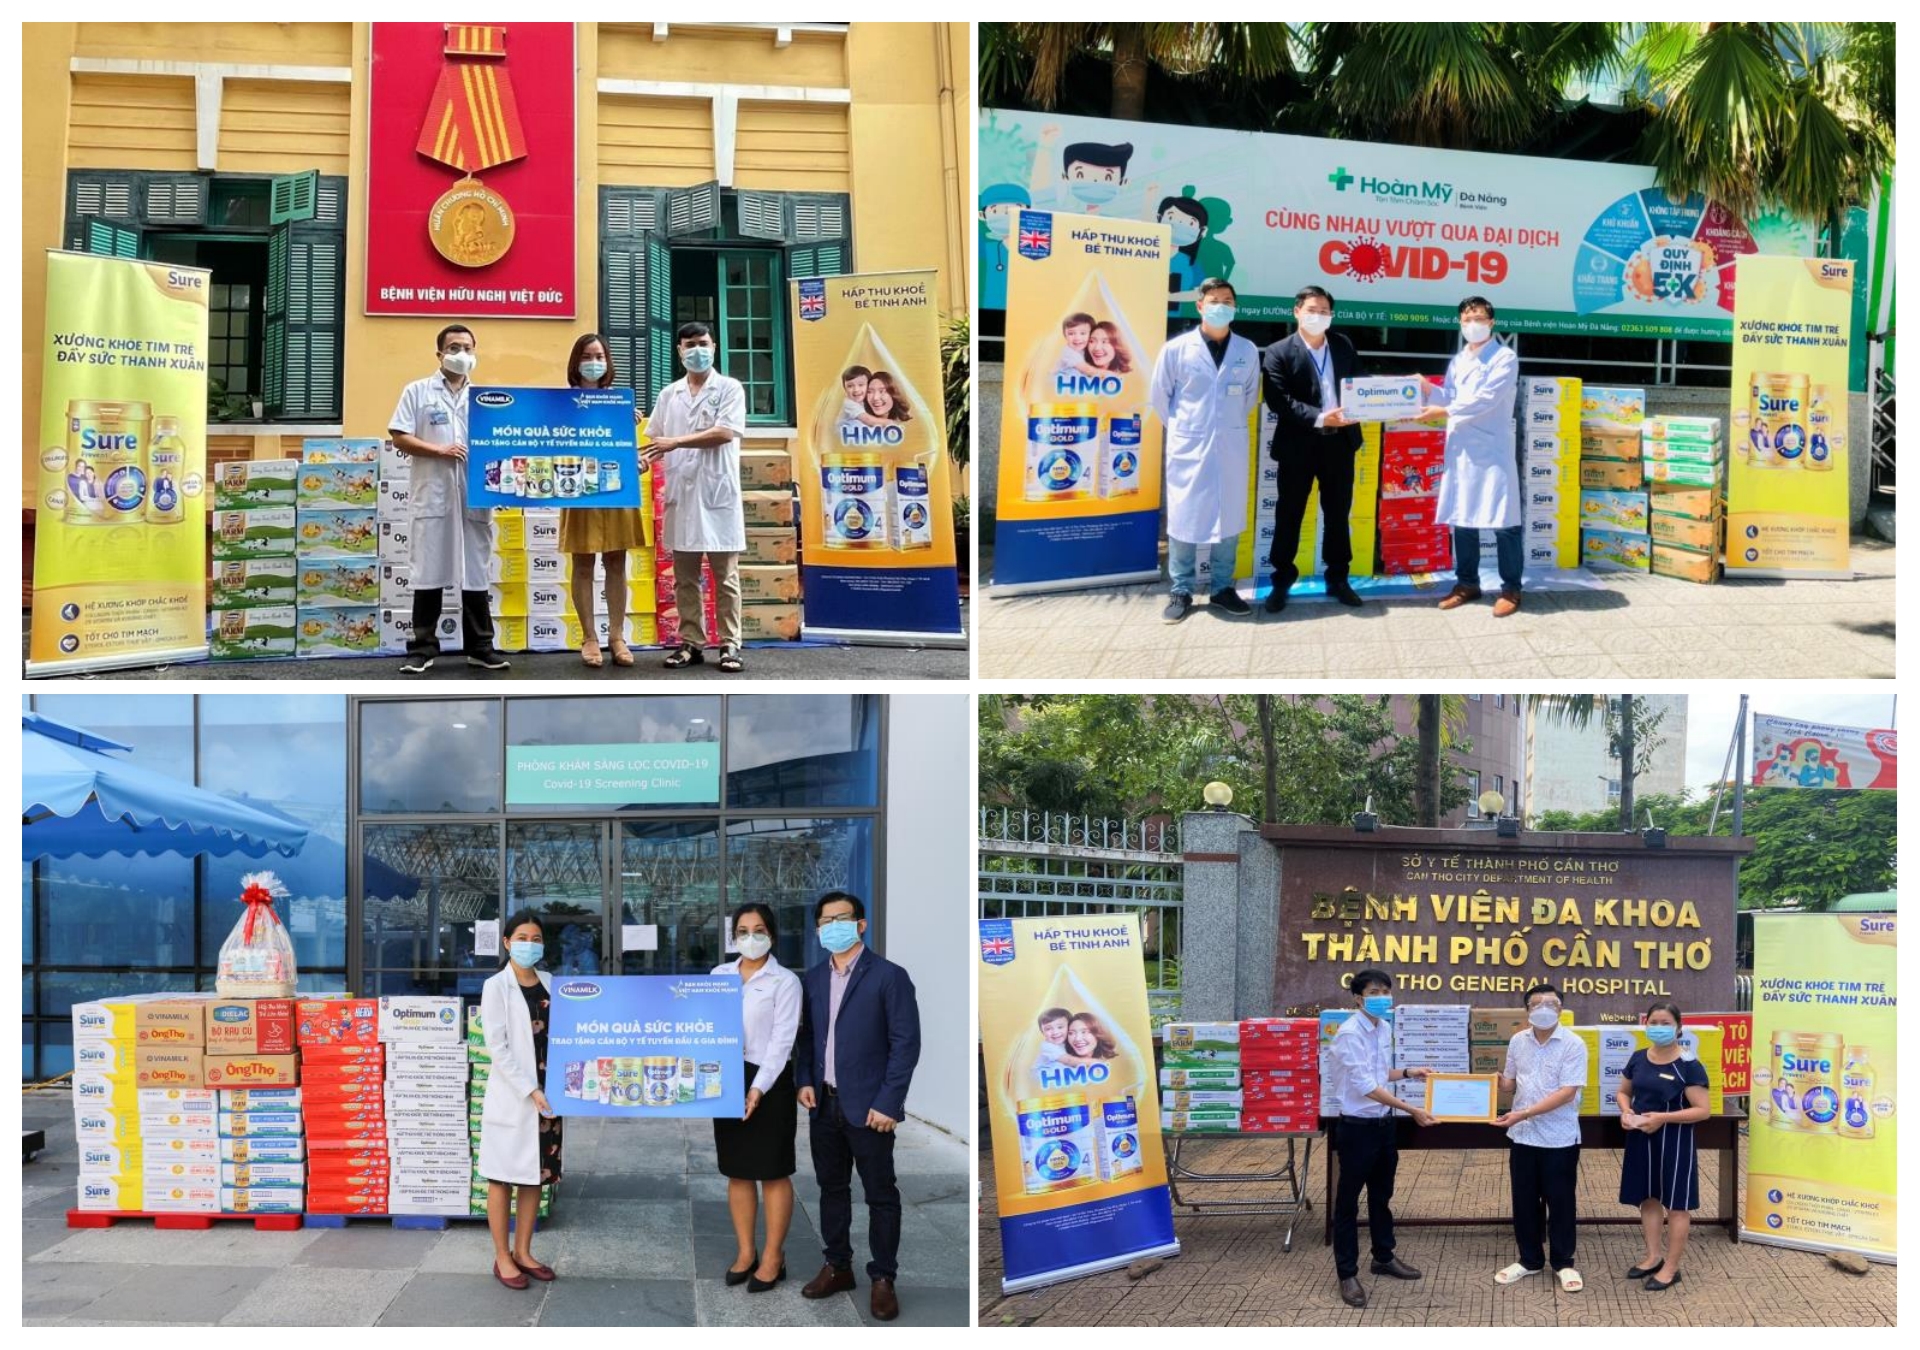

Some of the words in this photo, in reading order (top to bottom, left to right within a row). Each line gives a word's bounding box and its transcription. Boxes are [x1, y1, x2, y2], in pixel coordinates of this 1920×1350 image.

[1360, 176, 1417, 197] Hoàn
[1422, 181, 1453, 203] Mỹ
[1460, 192, 1475, 201] Đà
[1265, 208, 1320, 231] CÙNG
[1326, 215, 1380, 236] NHAU
[1386, 218, 1436, 243] VƯỢT
[1441, 223, 1479, 243] QUA
[1483, 225, 1513, 248] ĐẠI
[1518, 227, 1560, 250] DỊCH
[1072, 229, 1098, 241] HẤP
[1100, 233, 1125, 244] THU
[1104, 246, 1132, 256] TINH
[1134, 249, 1160, 259] ANH
[1663, 248, 1689, 259] QUY
[1660, 260, 1691, 273] ĐỊNH
[1821, 264, 1848, 277] Sure
[167, 271, 202, 288] Sure
[380, 285, 414, 302] BỆNH
[417, 286, 445, 303] VIỆN
[449, 286, 475, 301] HỮU
[477, 289, 506, 304] NGHỊ
[509, 288, 534, 305] VIỆT
[538, 288, 563, 303] ĐỨC
[842, 286, 865, 298] HẤP
[868, 286, 891, 296] THU
[872, 298, 899, 307] TINH
[902, 297, 927, 306] ANH
[1389, 313, 1409, 322] 1900
[1410, 314, 1429, 323] 9095
[1740, 319, 1775, 331] XƯƠNG
[1805, 324, 1822, 333] TIM
[53, 332, 104, 349] XƯƠNG
[146, 341, 169, 353] TIM
[1765, 333, 1783, 344] SỨC
[1786, 336, 1820, 346] THANH
[1822, 336, 1848, 347] XUÂN
[89, 351, 116, 365] SỨC
[121, 355, 166, 368] THANH
[170, 357, 205, 371] XUÂN
[1057, 375, 1122, 395] HMO
[1533, 385, 1554, 394] Sure
[480, 395, 510, 403] VINAMILK
[1357, 387, 1398, 398] Optimum
[1759, 394, 1800, 413] Sure
[493, 424, 522, 437] MÓN
[524, 425, 550, 438] QUÀ
[552, 425, 576, 437] SỨC
[579, 425, 612, 437] KHỎE
[842, 426, 902, 445] HMO
[1035, 423, 1089, 436] Optimum
[81, 427, 137, 450] Sure
[828, 473, 876, 484] Optimum
[1533, 493, 1553, 503] Sure
[533, 557, 558, 568] Sure
[517, 759, 555, 771] PHÒNG
[559, 758, 590, 771] KHÁM
[594, 758, 625, 770] SÀNG
[628, 760, 650, 771] LỌC
[654, 759, 708, 770] COVID-19
[544, 779, 592, 789] Covid-19
[595, 779, 648, 790] Screening
[651, 778, 681, 788] Clinic
[1402, 853, 1421, 867] SỞ
[1427, 857, 1436, 868] Y
[1441, 854, 1460, 869] TẾ
[1465, 857, 1514, 869] THÀNH
[1518, 857, 1549, 871] PHỐ
[1588, 861, 1619, 873] THƠ
[1407, 872, 1428, 881] CAN
[1432, 872, 1452, 881] THO
[1455, 873, 1479, 882] CITY
[1556, 876, 1570, 884] OF
[1572, 876, 1613, 885] HEALTH
[1310, 885, 1418, 927] BỆNH
[1430, 889, 1521, 932] VIỆN
[1531, 897, 1583, 926] ĐA
[1593, 898, 1701, 929] KHOA
[1860, 918, 1894, 931] Sure
[1034, 927, 1061, 940] HẤP
[1064, 929, 1090, 939] THU
[1069, 941, 1100, 950] TINH
[1103, 939, 1130, 948] ANH
[1301, 926, 1438, 964] THÀNH
[1449, 926, 1533, 967] PHỐ
[1541, 928, 1621, 969] CẦN
[1633, 937, 1712, 971] THƠ
[1401, 972, 1442, 992] THO
[1562, 977, 1672, 997] HOSPITAL
[1760, 978, 1802, 990] XƯƠNG
[1838, 982, 1861, 992] TIM
[1788, 991, 1812, 1003] SỨC
[1815, 994, 1857, 1005] THANH
[1861, 994, 1897, 1006] XUÂN
[80, 1015, 105, 1025] Sure
[393, 1008, 435, 1019] Optimum
[225, 1027, 239, 1035] RAU
[576, 1020, 609, 1033] MÓN
[611, 1020, 639, 1033] QUÀ
[644, 1020, 672, 1033] SỨC
[675, 1018, 714, 1033] KHỎE
[597, 1036, 615, 1045] CÁN
[616, 1037, 626, 1046] BỘ
[1606, 1038, 1629, 1047] Sure
[1783, 1053, 1831, 1073] Sure
[1041, 1063, 1109, 1089] HMO
[1026, 1113, 1082, 1130] Optimum
[85, 1186, 110, 1196] Sure
